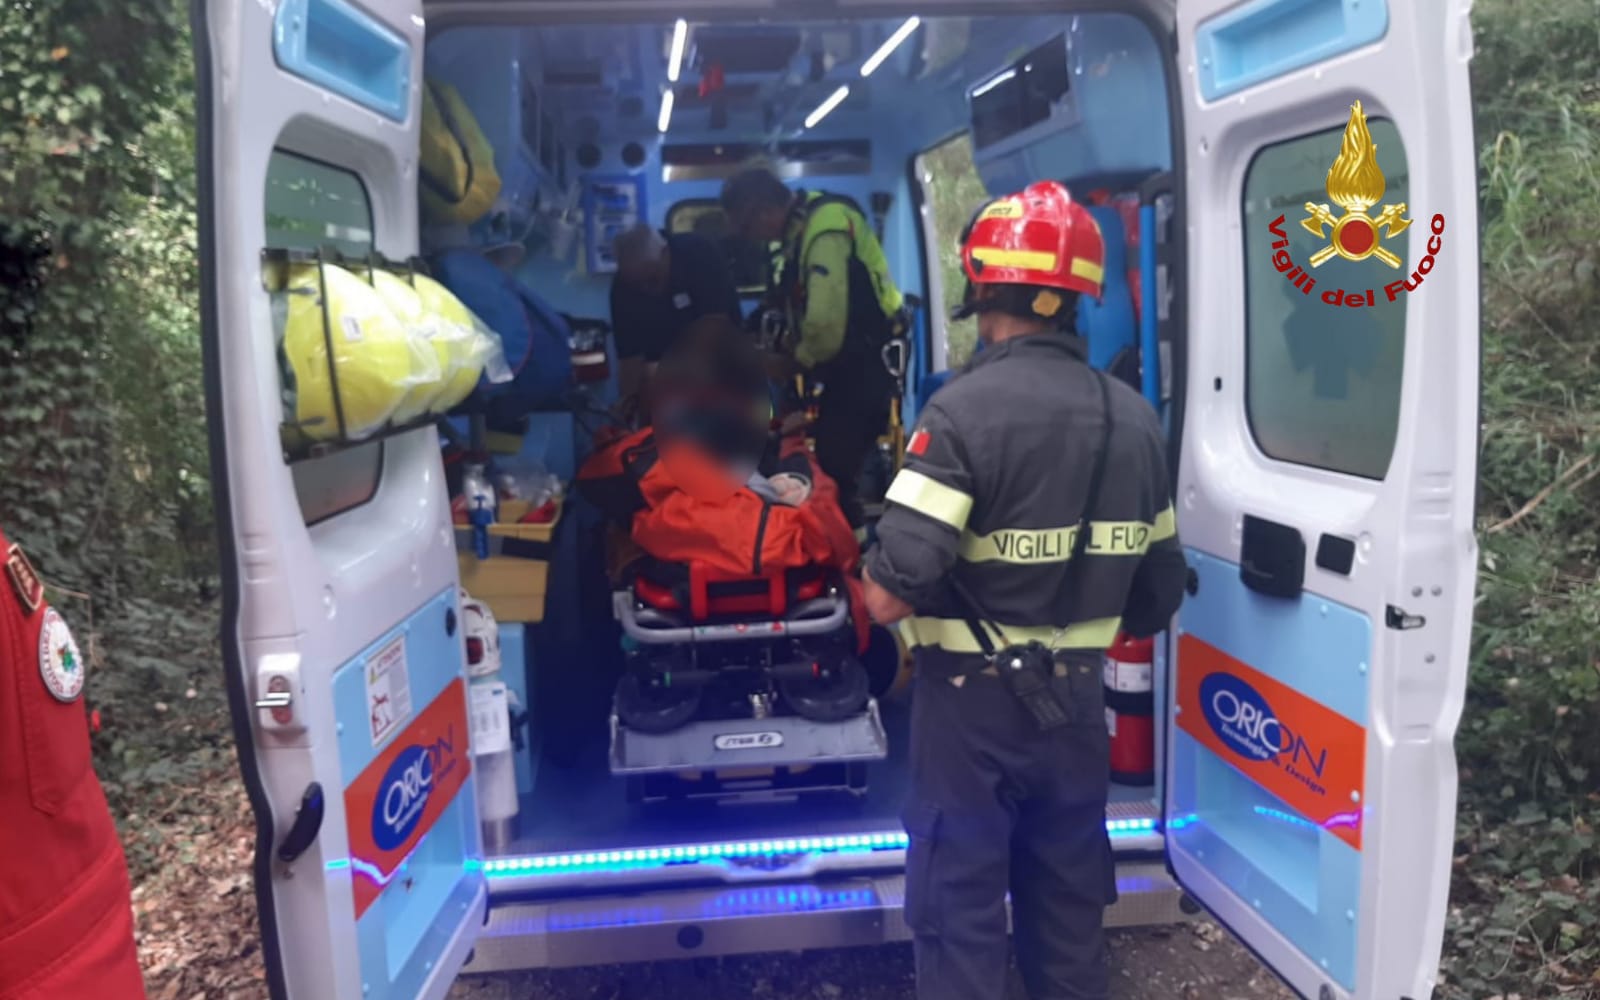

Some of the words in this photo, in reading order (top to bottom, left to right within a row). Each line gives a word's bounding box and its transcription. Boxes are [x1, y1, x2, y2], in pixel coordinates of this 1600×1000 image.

[993, 532, 1061, 559] VIGILI
[383, 722, 454, 826] ORION
[1212, 689, 1328, 778] ORION
